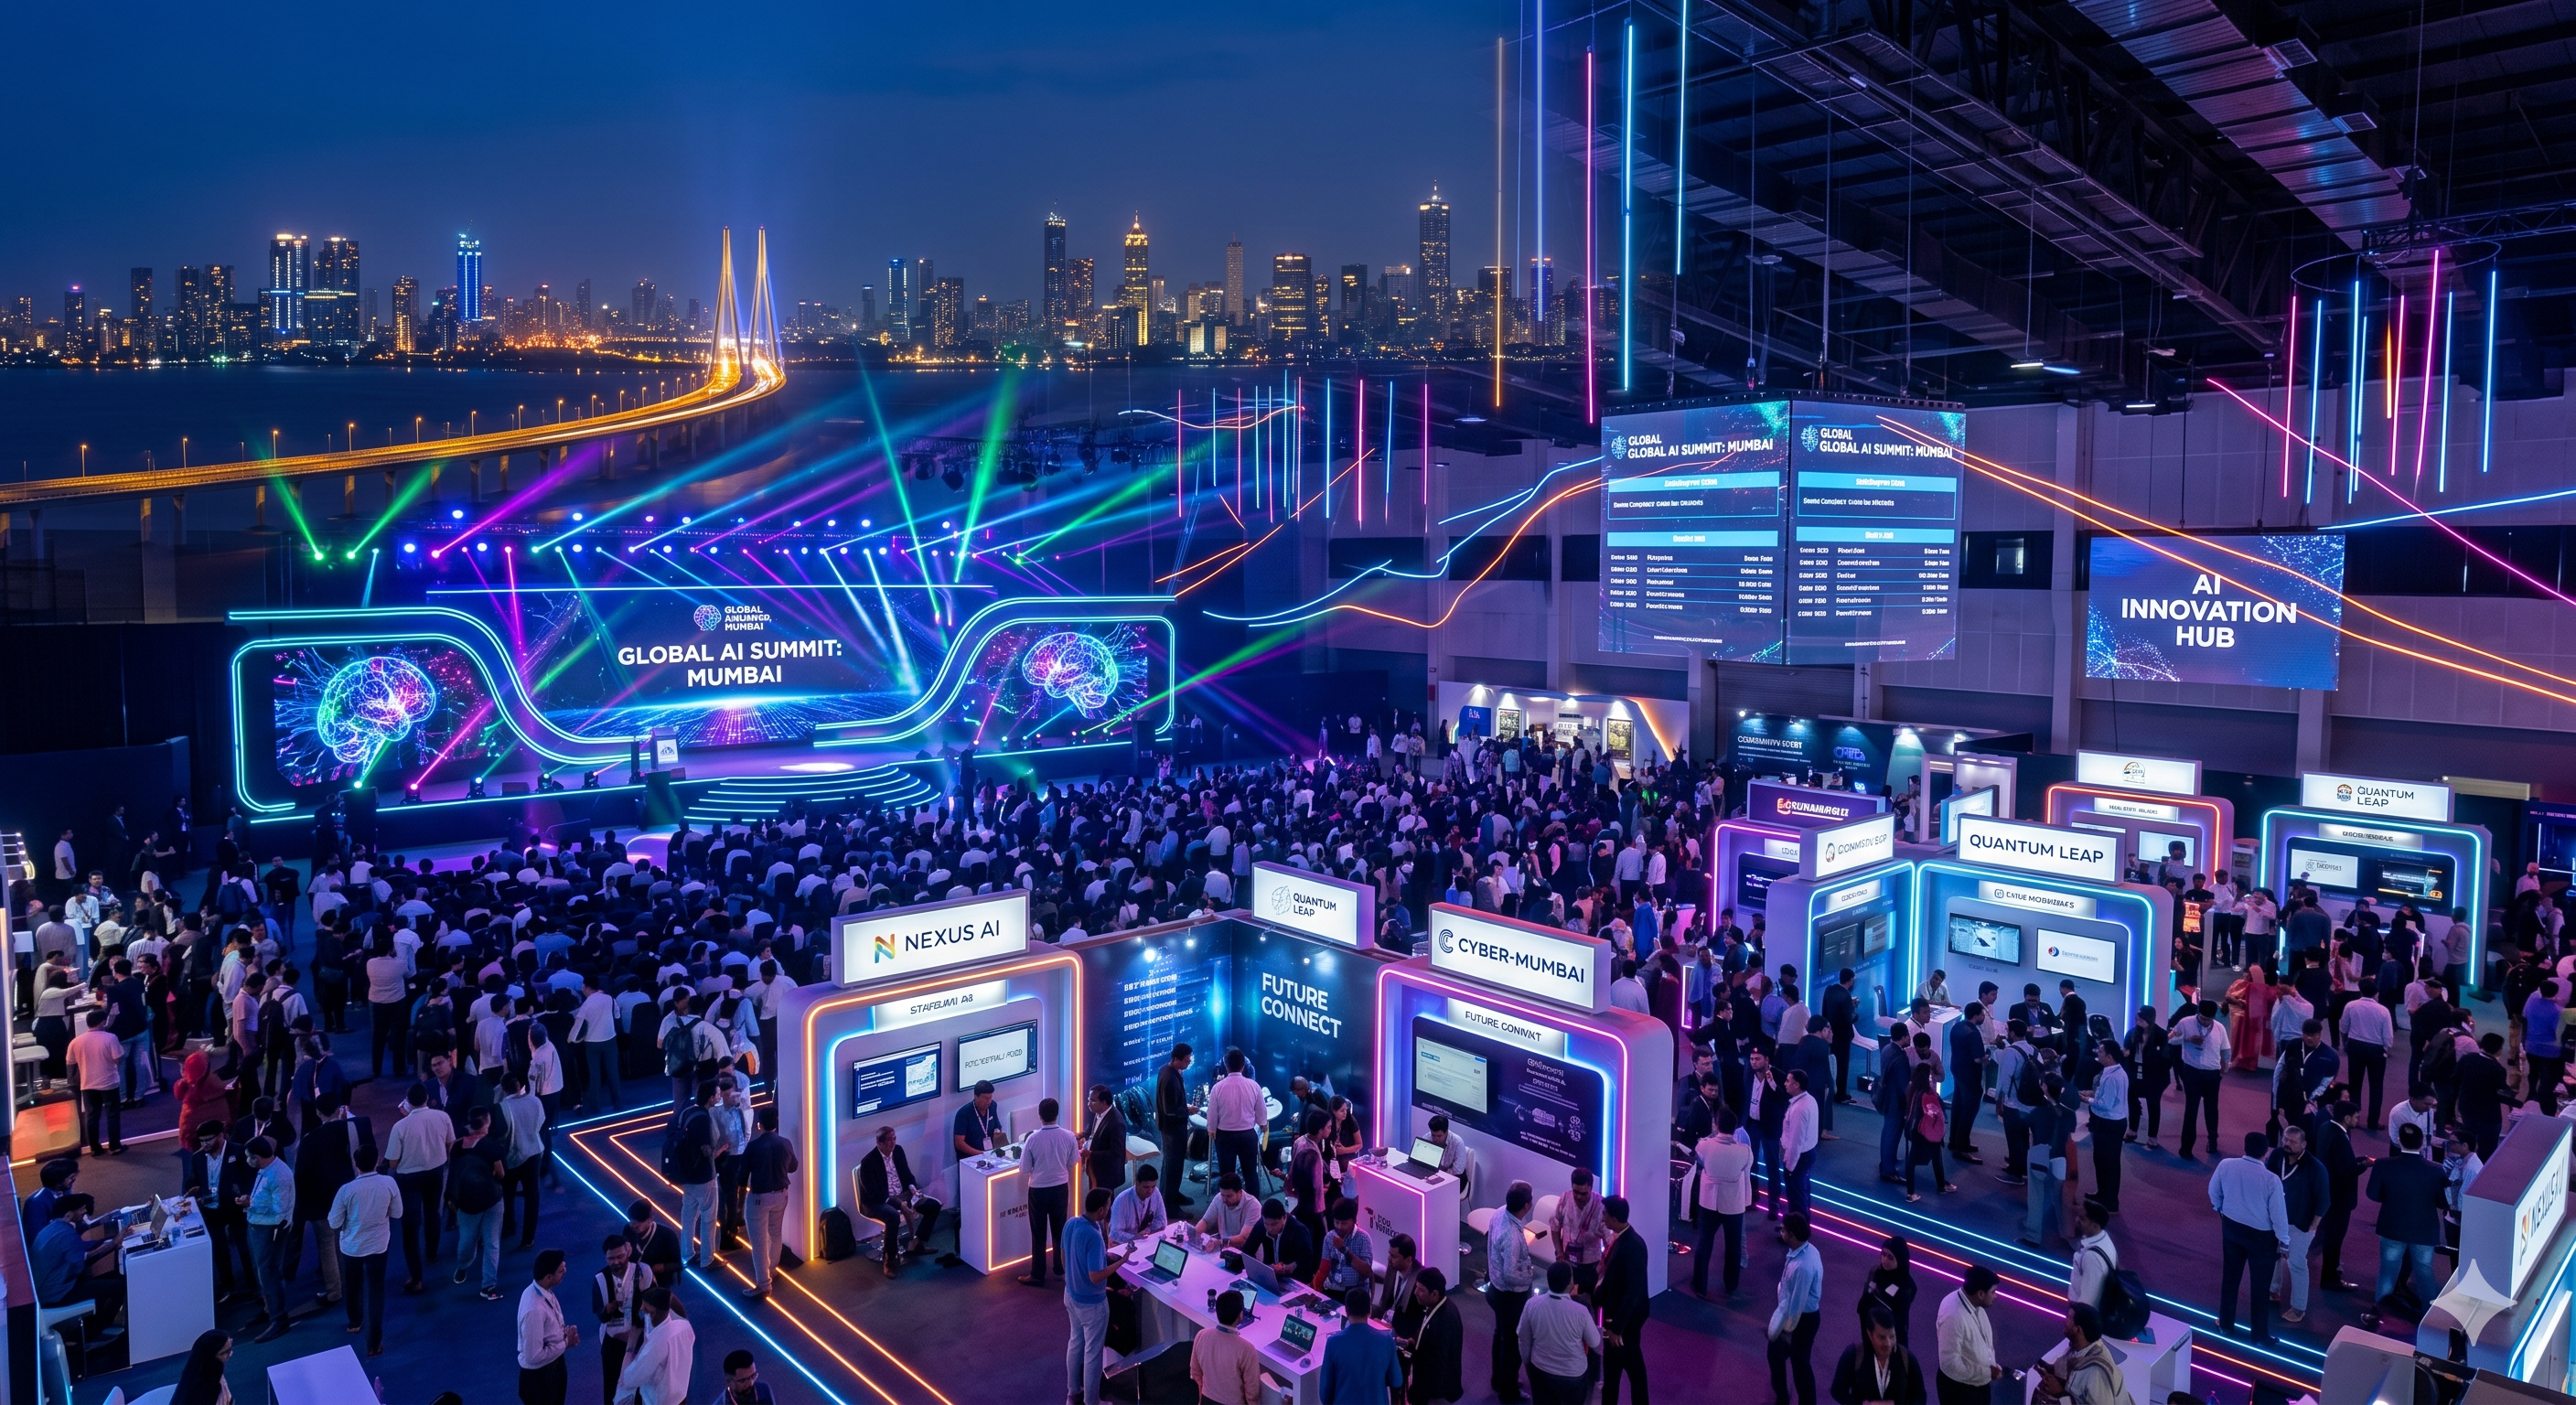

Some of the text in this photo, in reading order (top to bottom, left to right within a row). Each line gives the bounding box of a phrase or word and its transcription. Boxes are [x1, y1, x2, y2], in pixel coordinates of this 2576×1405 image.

[1628, 434, 1662, 446] GLOBAL
[1820, 428, 1852, 440] GLOBAL
[1627, 438, 1774, 459] GLOBAL AI SUMMIT: MUMBAI
[1819, 440, 1953, 458] GLOBAL AI SUMMIT: MUMBAI
[2192, 574, 2221, 595] AI
[724, 606, 763, 614] GLOBAL
[2121, 598, 2297, 623] INNOVATION
[724, 623, 764, 631] MUMBAI
[2175, 626, 2235, 648] HUB
[617, 639, 843, 666] GLOBAL AI SUMMIT:
[688, 665, 782, 687] MUMBAI
[2357, 785, 2414, 799] QUANTUM
[2357, 797, 2389, 807] LEAP
[1970, 833, 2104, 863] QUANTUM LEAP
[1293, 893, 1336, 912] QUANTUM
[1293, 905, 1315, 917] LEAP
[906, 924, 974, 952] NEXUS
[980, 919, 1000, 938] AI
[1458, 938, 1584, 983] CYBER-MUMBAI
[1262, 971, 1329, 1012] FUTURE
[1261, 996, 1342, 1038] CONNECT
[1465, 1011, 1499, 1029] FUTURE
